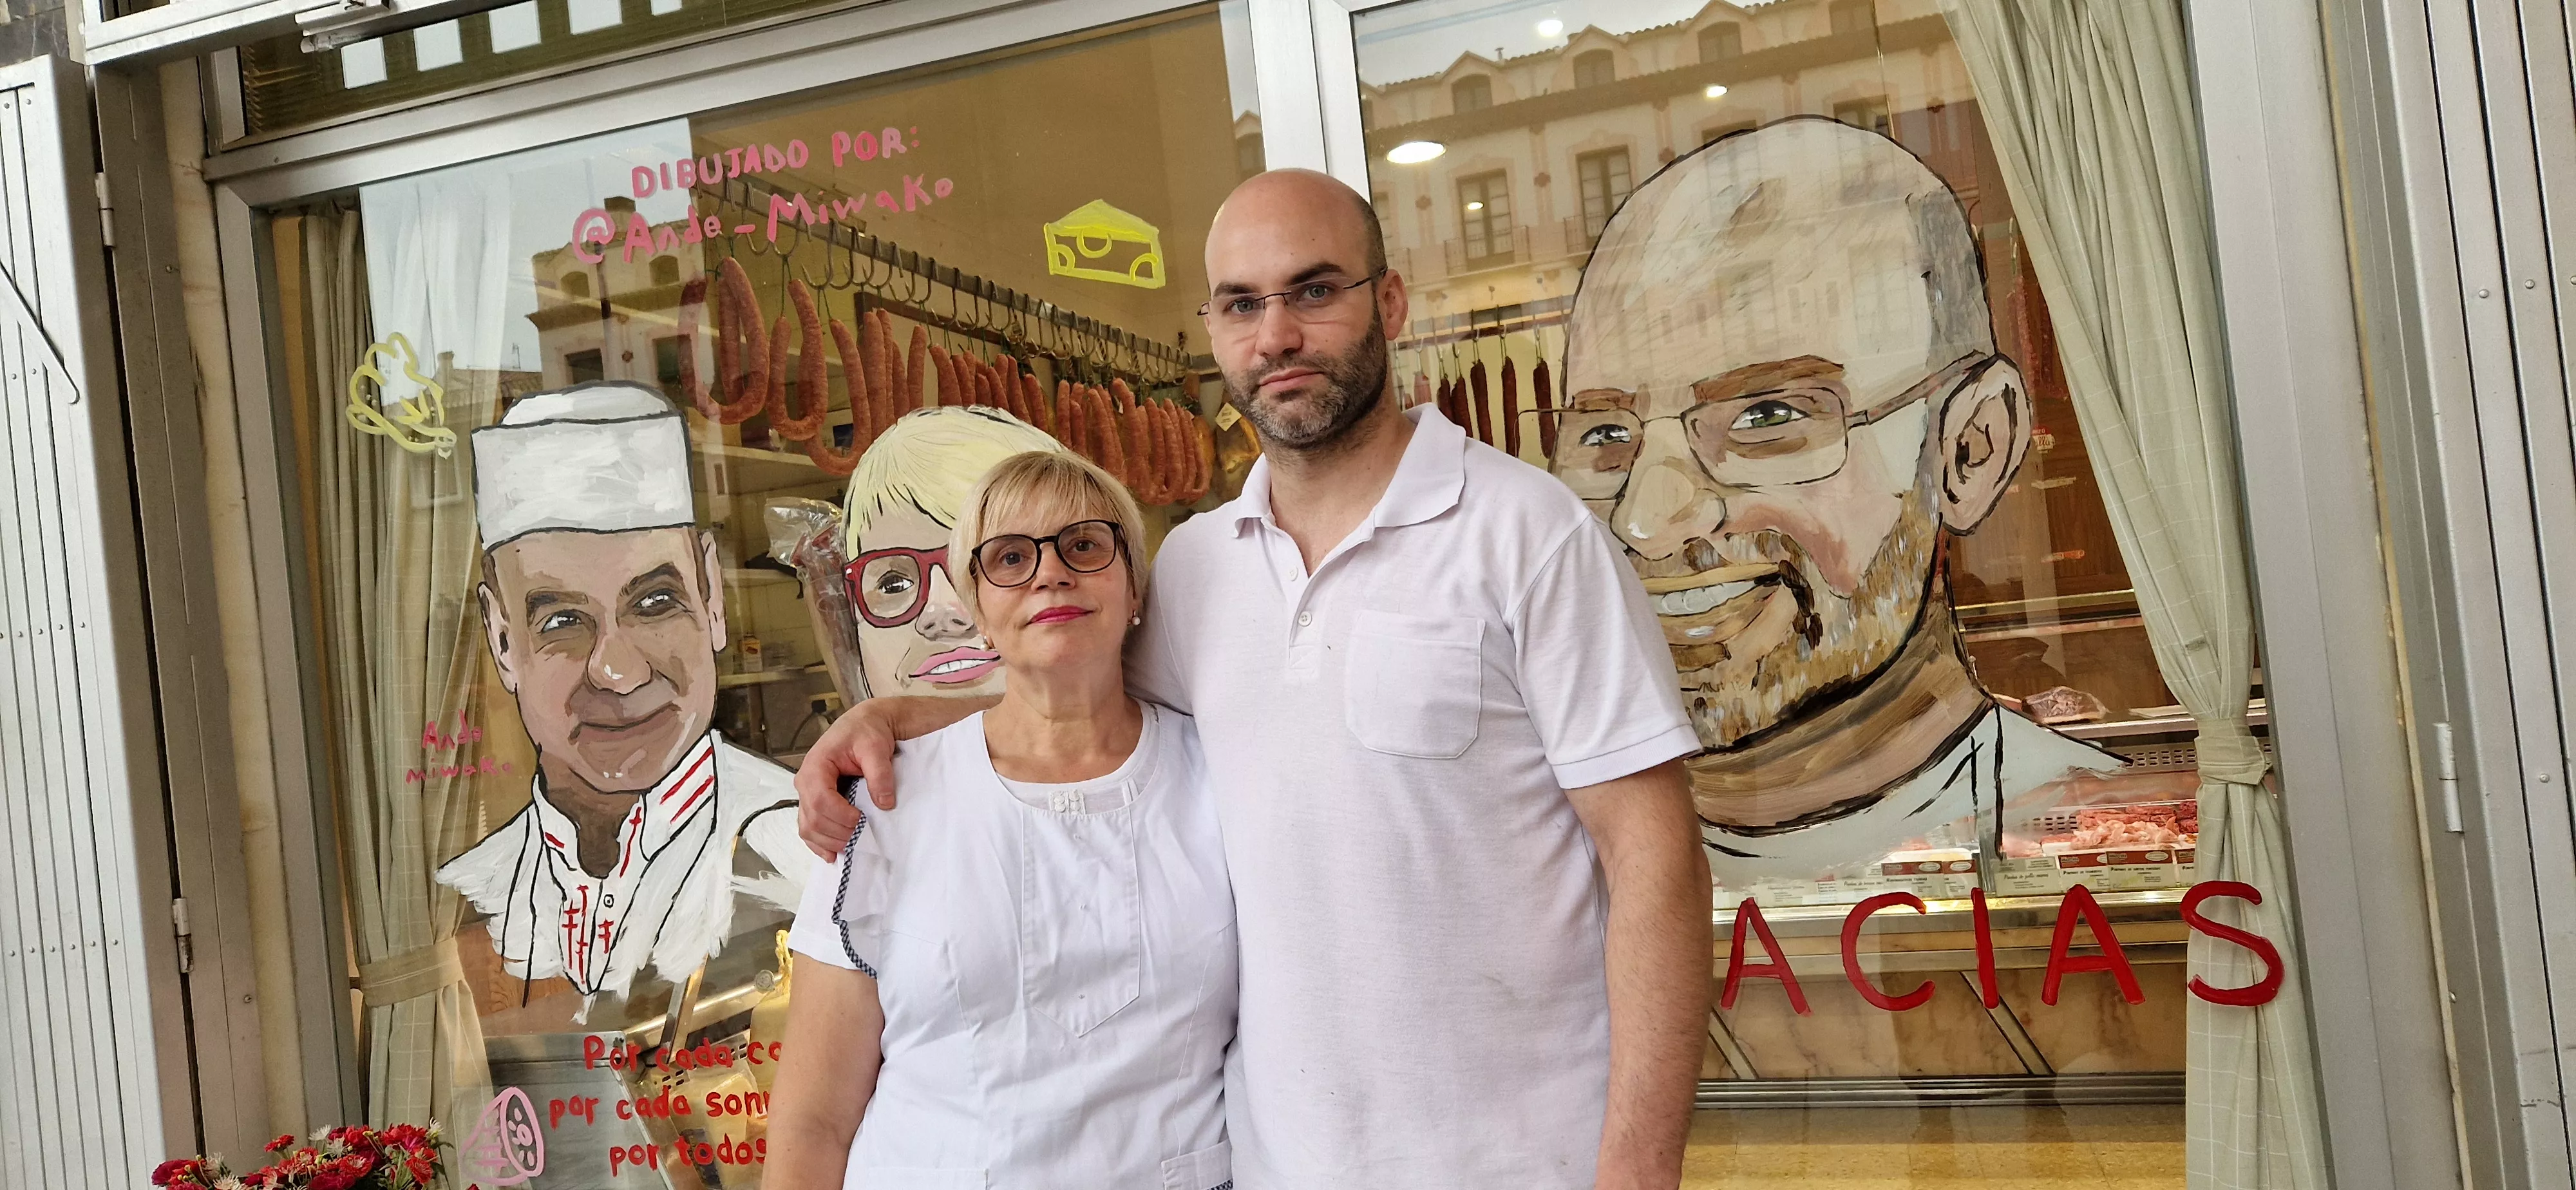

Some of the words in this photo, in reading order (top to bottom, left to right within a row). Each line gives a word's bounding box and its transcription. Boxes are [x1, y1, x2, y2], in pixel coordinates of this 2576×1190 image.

[631, 139, 810, 198] DIBUJADO
[831, 127, 920, 167] POR:
[583, 1035, 641, 1072] Por
[654, 1037, 734, 1073] cada
[549, 1095, 600, 1131] por
[615, 1084, 693, 1121] cada
[609, 1144, 660, 1178] por
